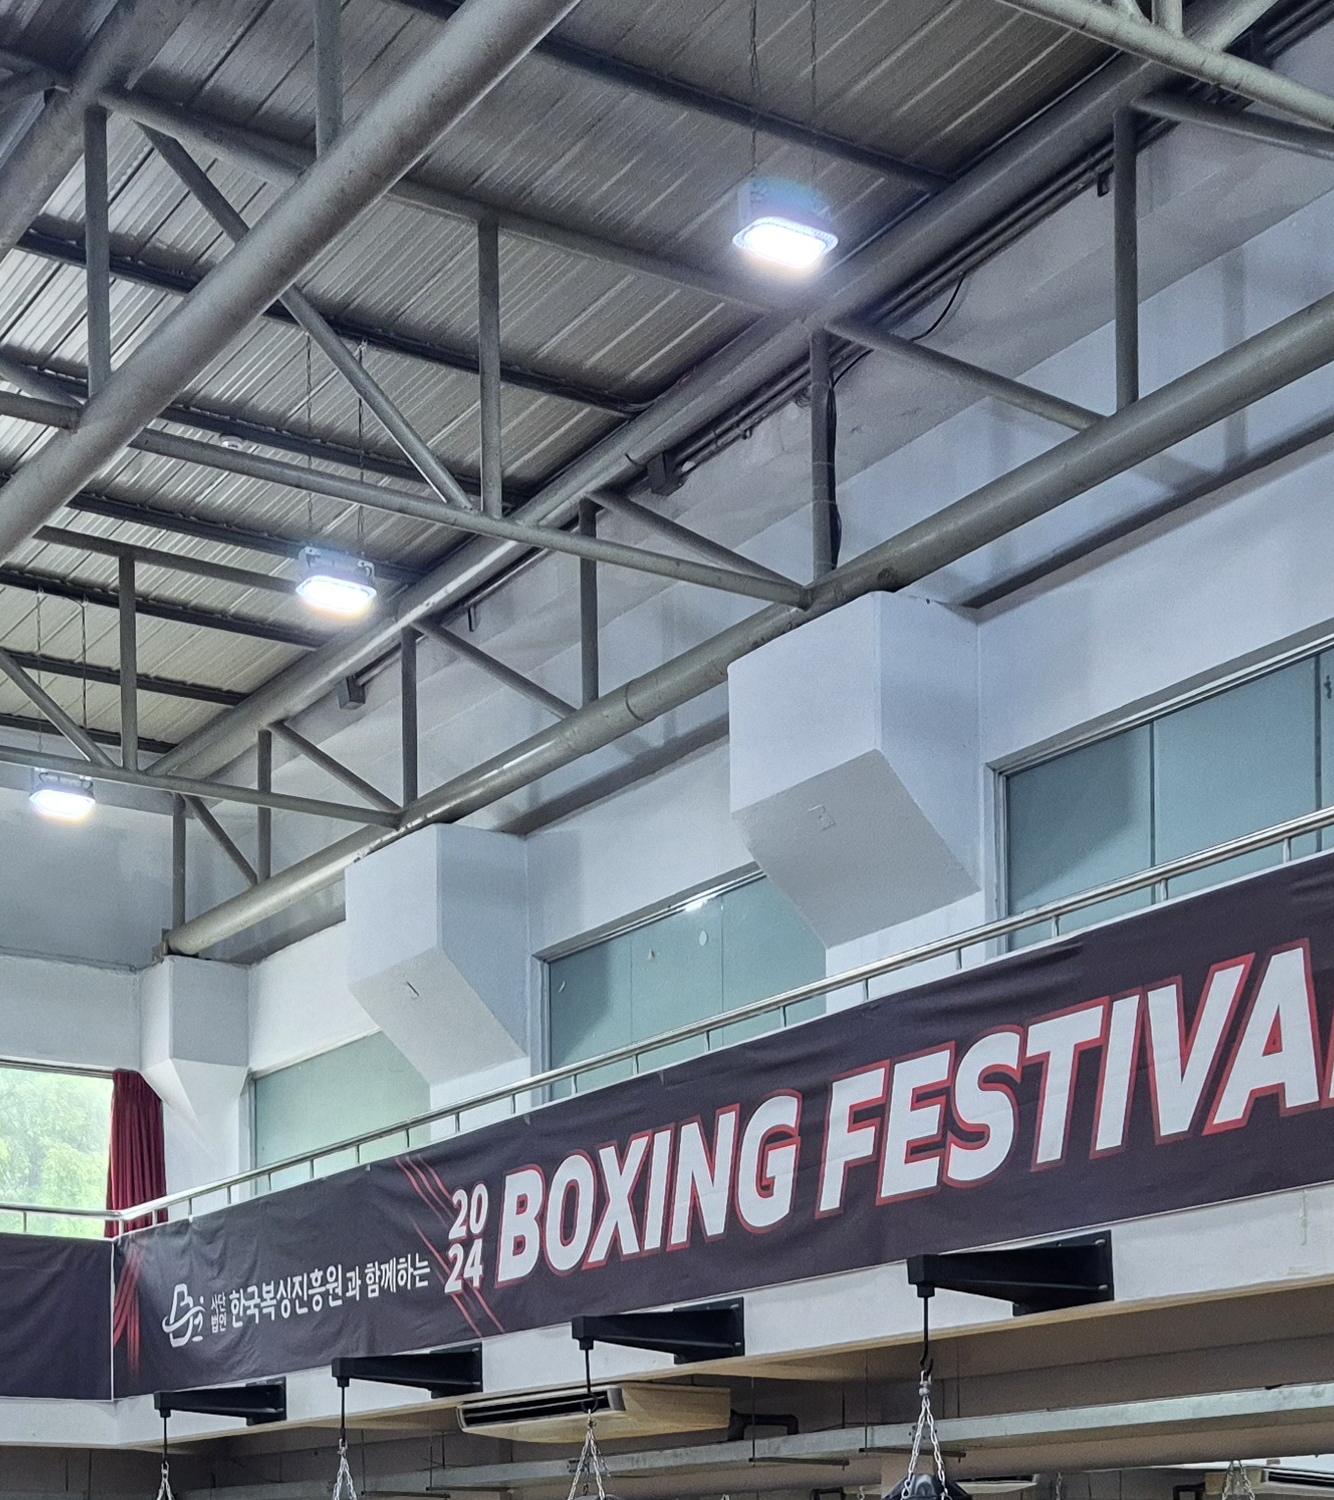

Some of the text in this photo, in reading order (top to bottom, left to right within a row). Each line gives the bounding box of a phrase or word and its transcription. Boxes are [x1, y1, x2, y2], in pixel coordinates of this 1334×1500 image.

[448, 1182, 489, 1242] 20
[496, 1090, 802, 1288] BOXING
[364, 1252, 431, 1299] 함께하는
[444, 1237, 484, 1295] 24
[210, 1291, 226, 1313] 사단
[210, 1312, 227, 1334] 법인
